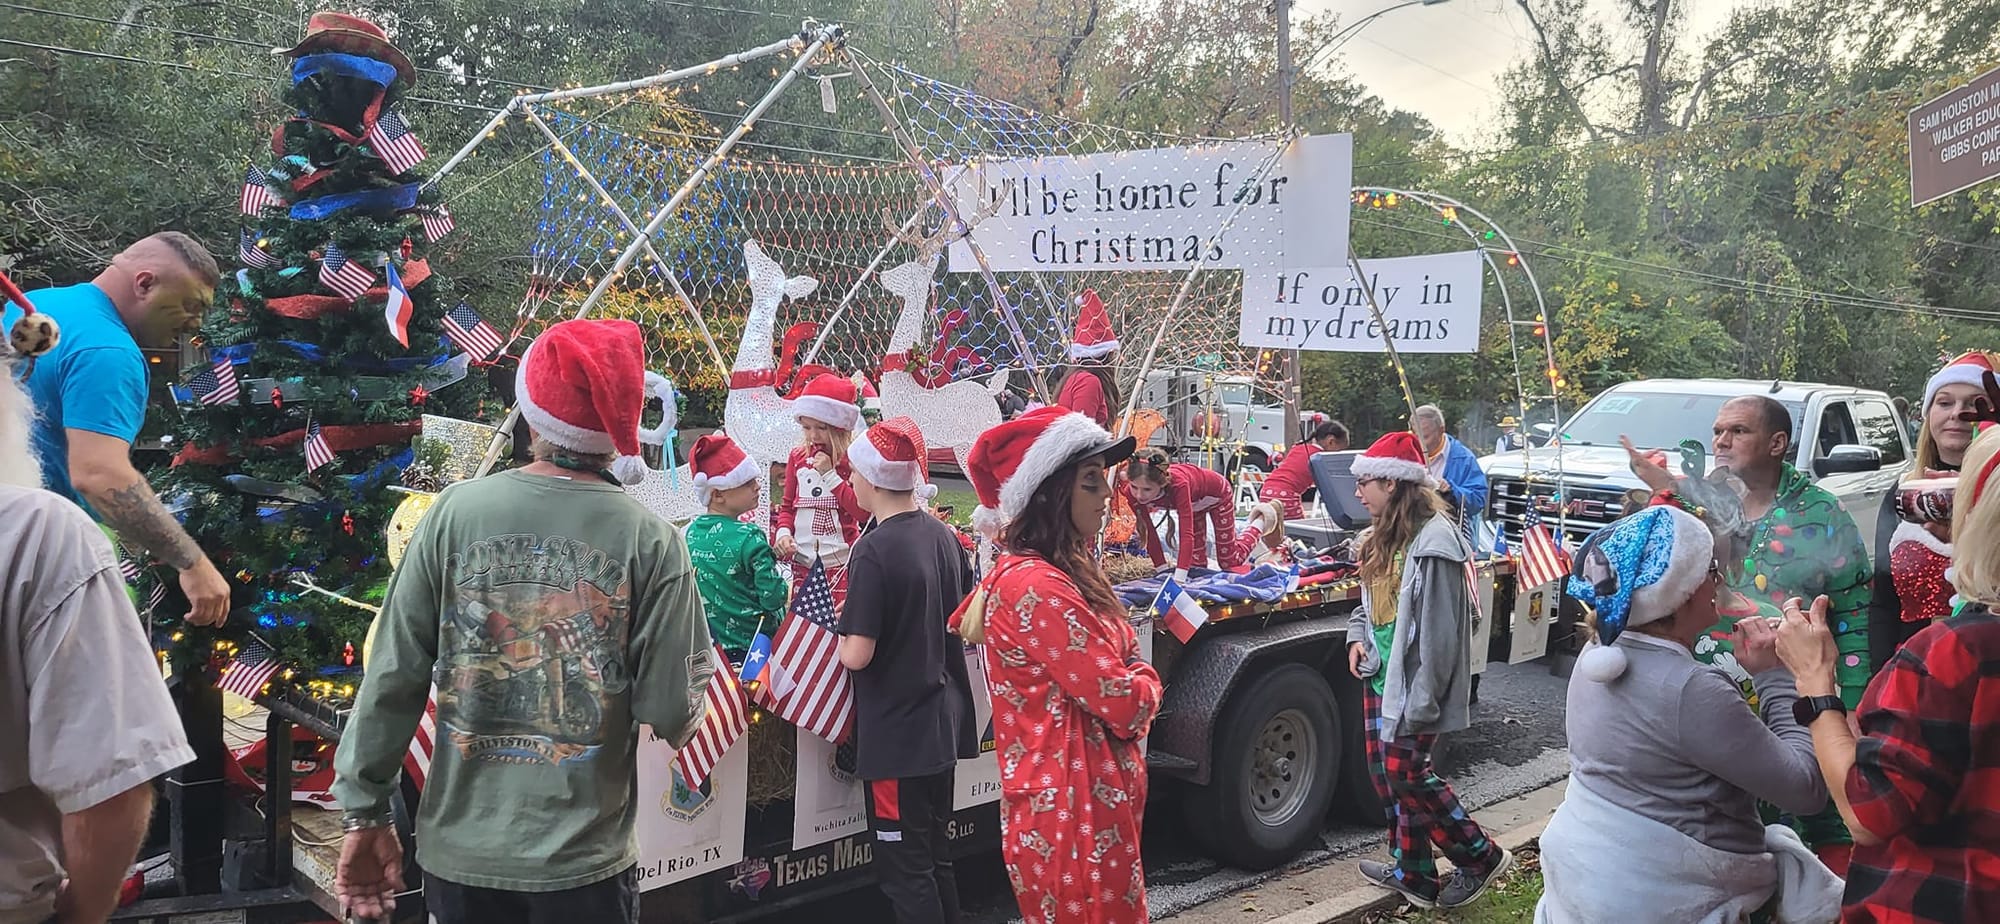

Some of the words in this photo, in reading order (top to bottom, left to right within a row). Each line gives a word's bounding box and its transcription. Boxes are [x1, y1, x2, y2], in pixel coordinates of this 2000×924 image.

[1919, 111, 1940, 133] SAM
[1941, 87, 1988, 123] HOUSTON
[1932, 116, 1973, 146] WALKER
[1941, 138, 1970, 162] GIBBS
[1042, 175, 1078, 215] be
[1094, 172, 1197, 212] home
[1213, 162, 1288, 207] for
[1031, 225, 1223, 264] Christmas
[1274, 272, 1309, 304] If
[1322, 273, 1400, 317] only
[1420, 274, 1452, 305] in
[1535, 495, 1605, 517] GMC
[445, 533, 536, 587] LONE
[542, 535, 628, 598] STAR
[971, 781, 982, 797] El
[814, 819, 846, 833] Wichita
[636, 859, 662, 882] Del
[703, 846, 722, 863] TX
[774, 854, 828, 888] TEXAS
[960, 822, 975, 837] LLC
